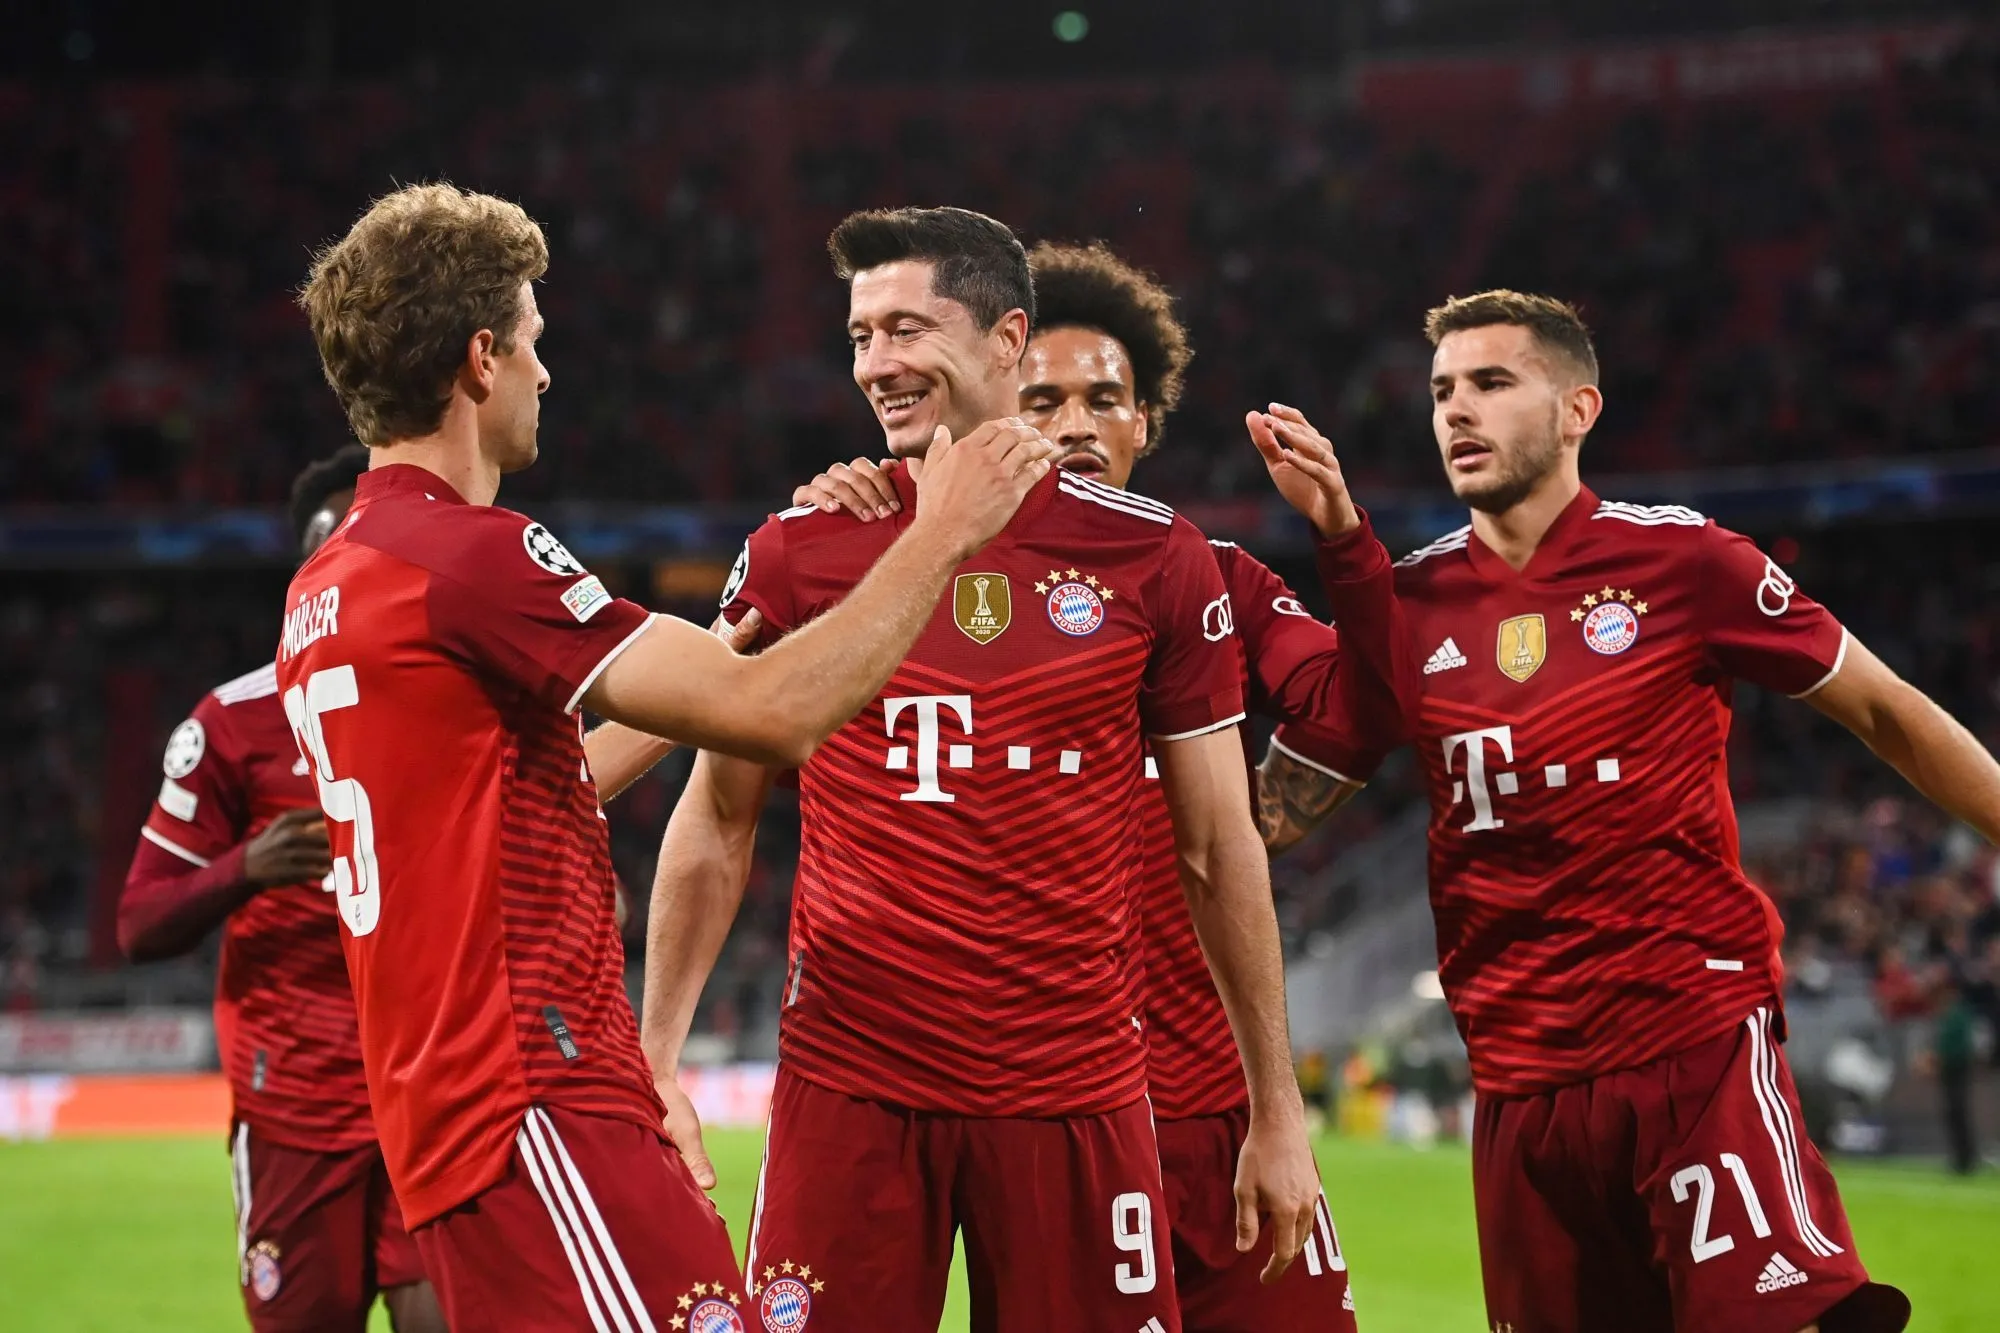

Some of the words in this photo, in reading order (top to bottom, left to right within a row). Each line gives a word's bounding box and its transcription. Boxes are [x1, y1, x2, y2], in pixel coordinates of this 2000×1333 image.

[1052, 592, 1064, 605] FC
[1062, 586, 1099, 607] BAYERN
[282, 585, 339, 663] MÜLLER
[970, 616, 996, 626] FIFA
[1423, 655, 1468, 675] adidas
[1511, 656, 1534, 667] FIFA
[1670, 1153, 1772, 1263] 21
[1112, 1192, 1157, 1294] 9
[764, 1291, 775, 1305] FC
[774, 1282, 808, 1305] BAYERN
[1755, 1271, 1809, 1294] adidas
[697, 1304, 735, 1321] BAYERN
